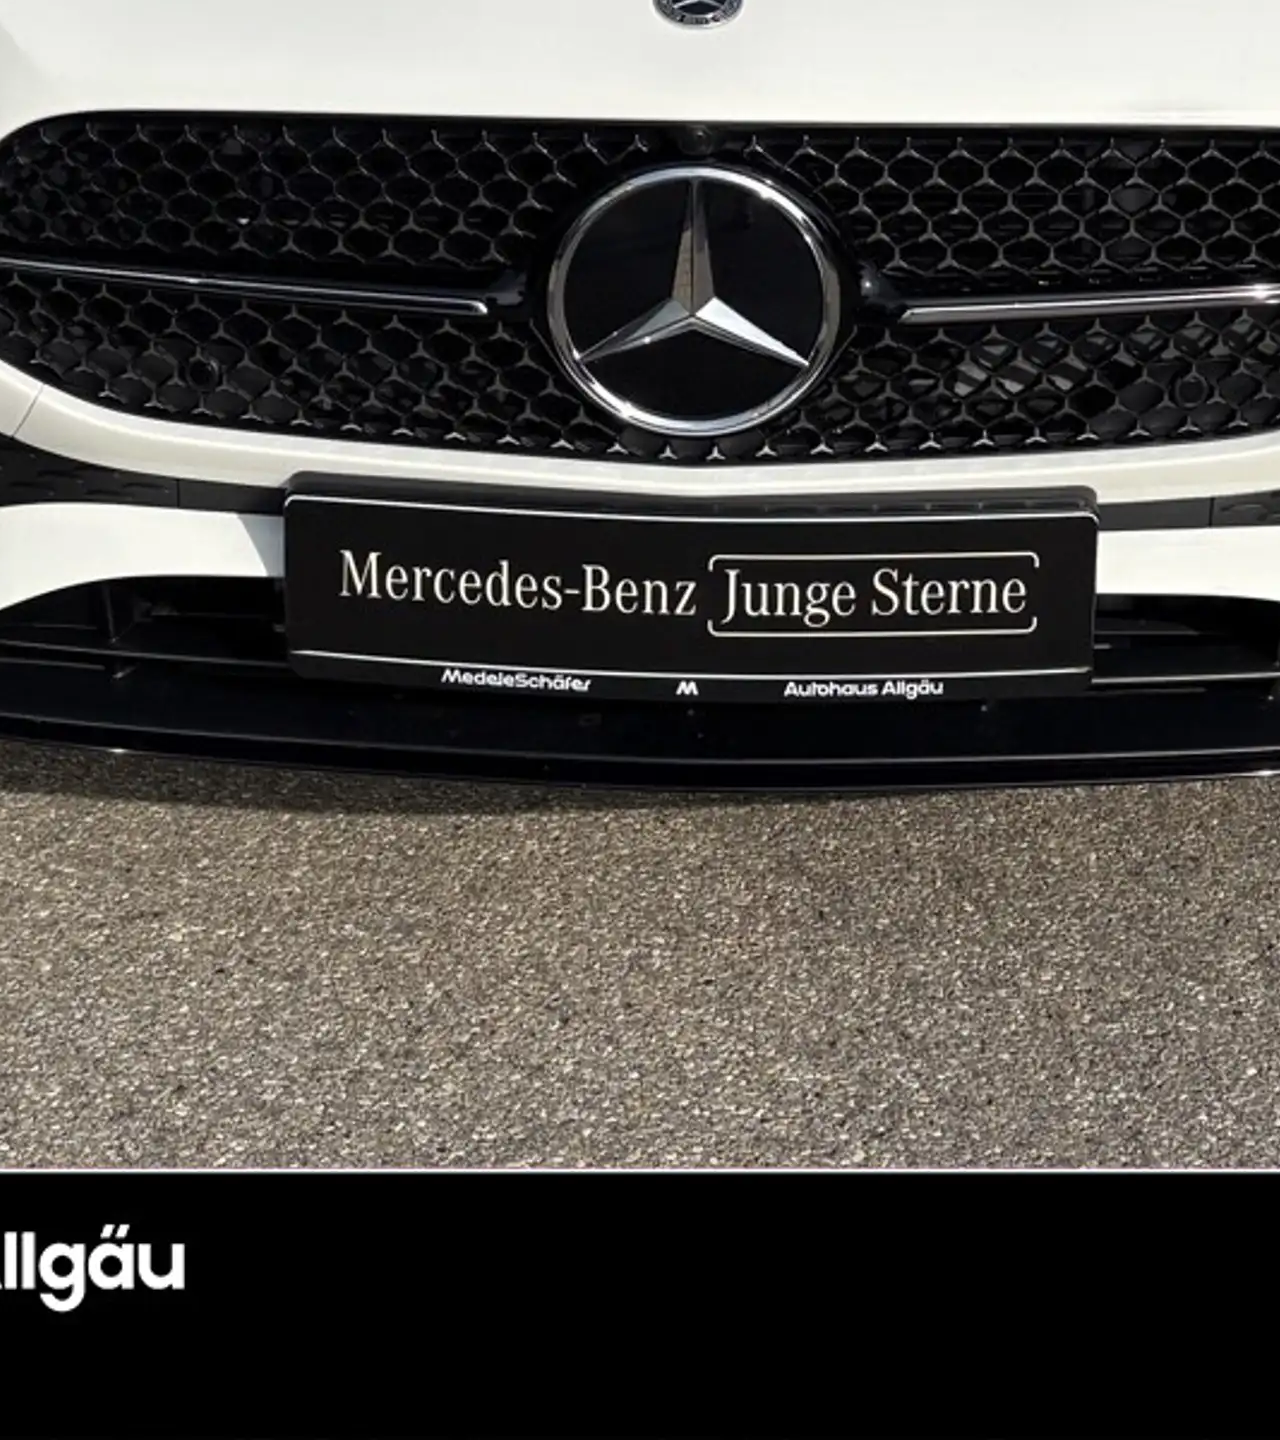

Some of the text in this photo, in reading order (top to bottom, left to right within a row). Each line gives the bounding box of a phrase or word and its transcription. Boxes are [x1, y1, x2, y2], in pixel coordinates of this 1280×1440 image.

[339, 549, 1028, 628] Mercedes-Benz Junge Sterne
[441, 668, 591, 692] MedeleSchäfer
[784, 679, 945, 702] Autohaus Allgäu
